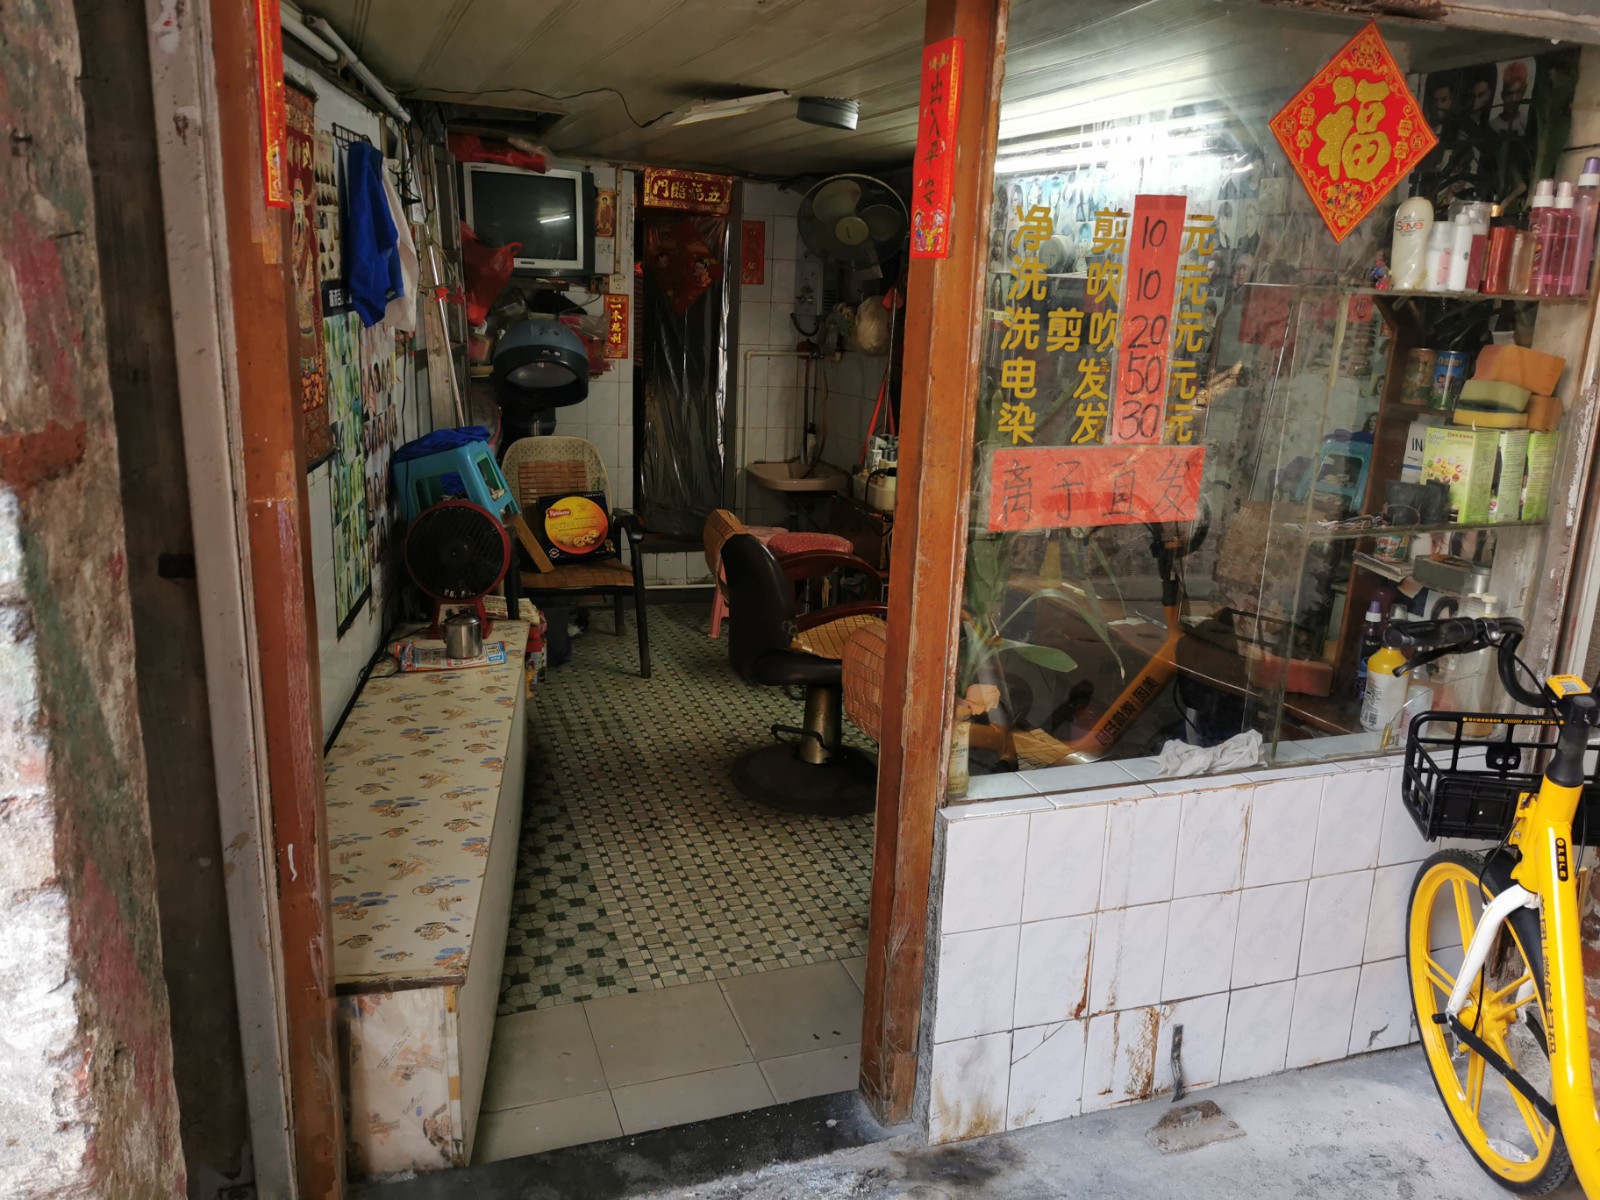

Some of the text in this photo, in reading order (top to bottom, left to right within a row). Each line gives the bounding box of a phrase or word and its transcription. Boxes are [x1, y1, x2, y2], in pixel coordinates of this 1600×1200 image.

[1316, 75, 1392, 183] 福
[1012, 204, 1216, 256] 净剪 10 元
[1008, 255, 1209, 306] 洗吹 10 元
[1000, 306, 1205, 353] 洗剪吹 20 元
[1001, 350, 1198, 401] 电发 50 元
[998, 400, 1193, 445] 染发 30 元
